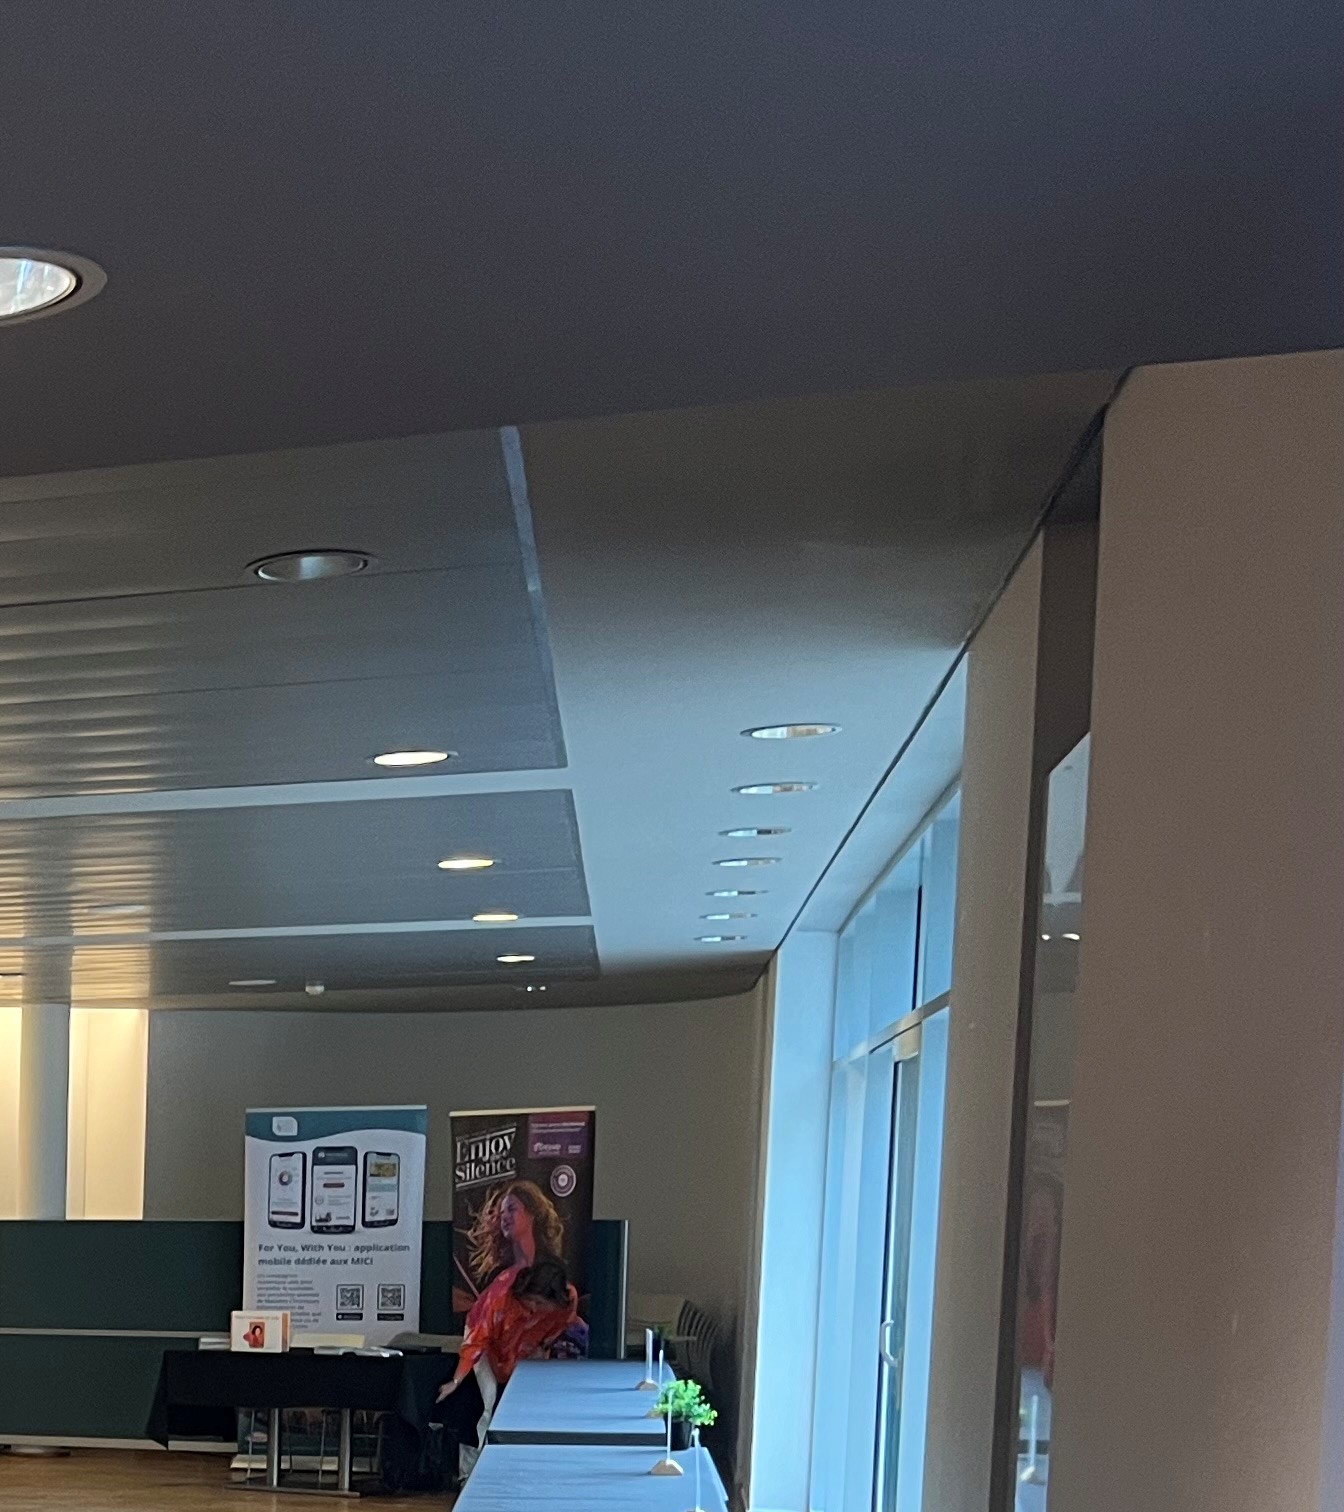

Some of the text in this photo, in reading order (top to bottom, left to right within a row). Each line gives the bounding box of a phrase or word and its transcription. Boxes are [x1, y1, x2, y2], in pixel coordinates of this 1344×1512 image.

[456, 1133, 516, 1163] Enjoy
[455, 1157, 516, 1182] Silence
[258, 1244, 274, 1252] For
[276, 1244, 298, 1253] You,
[301, 1243, 324, 1252] With
[327, 1244, 346, 1252] You
[353, 1243, 410, 1254] application
[258, 1258, 292, 1266] mobile
[294, 1257, 327, 1266] dédiée
